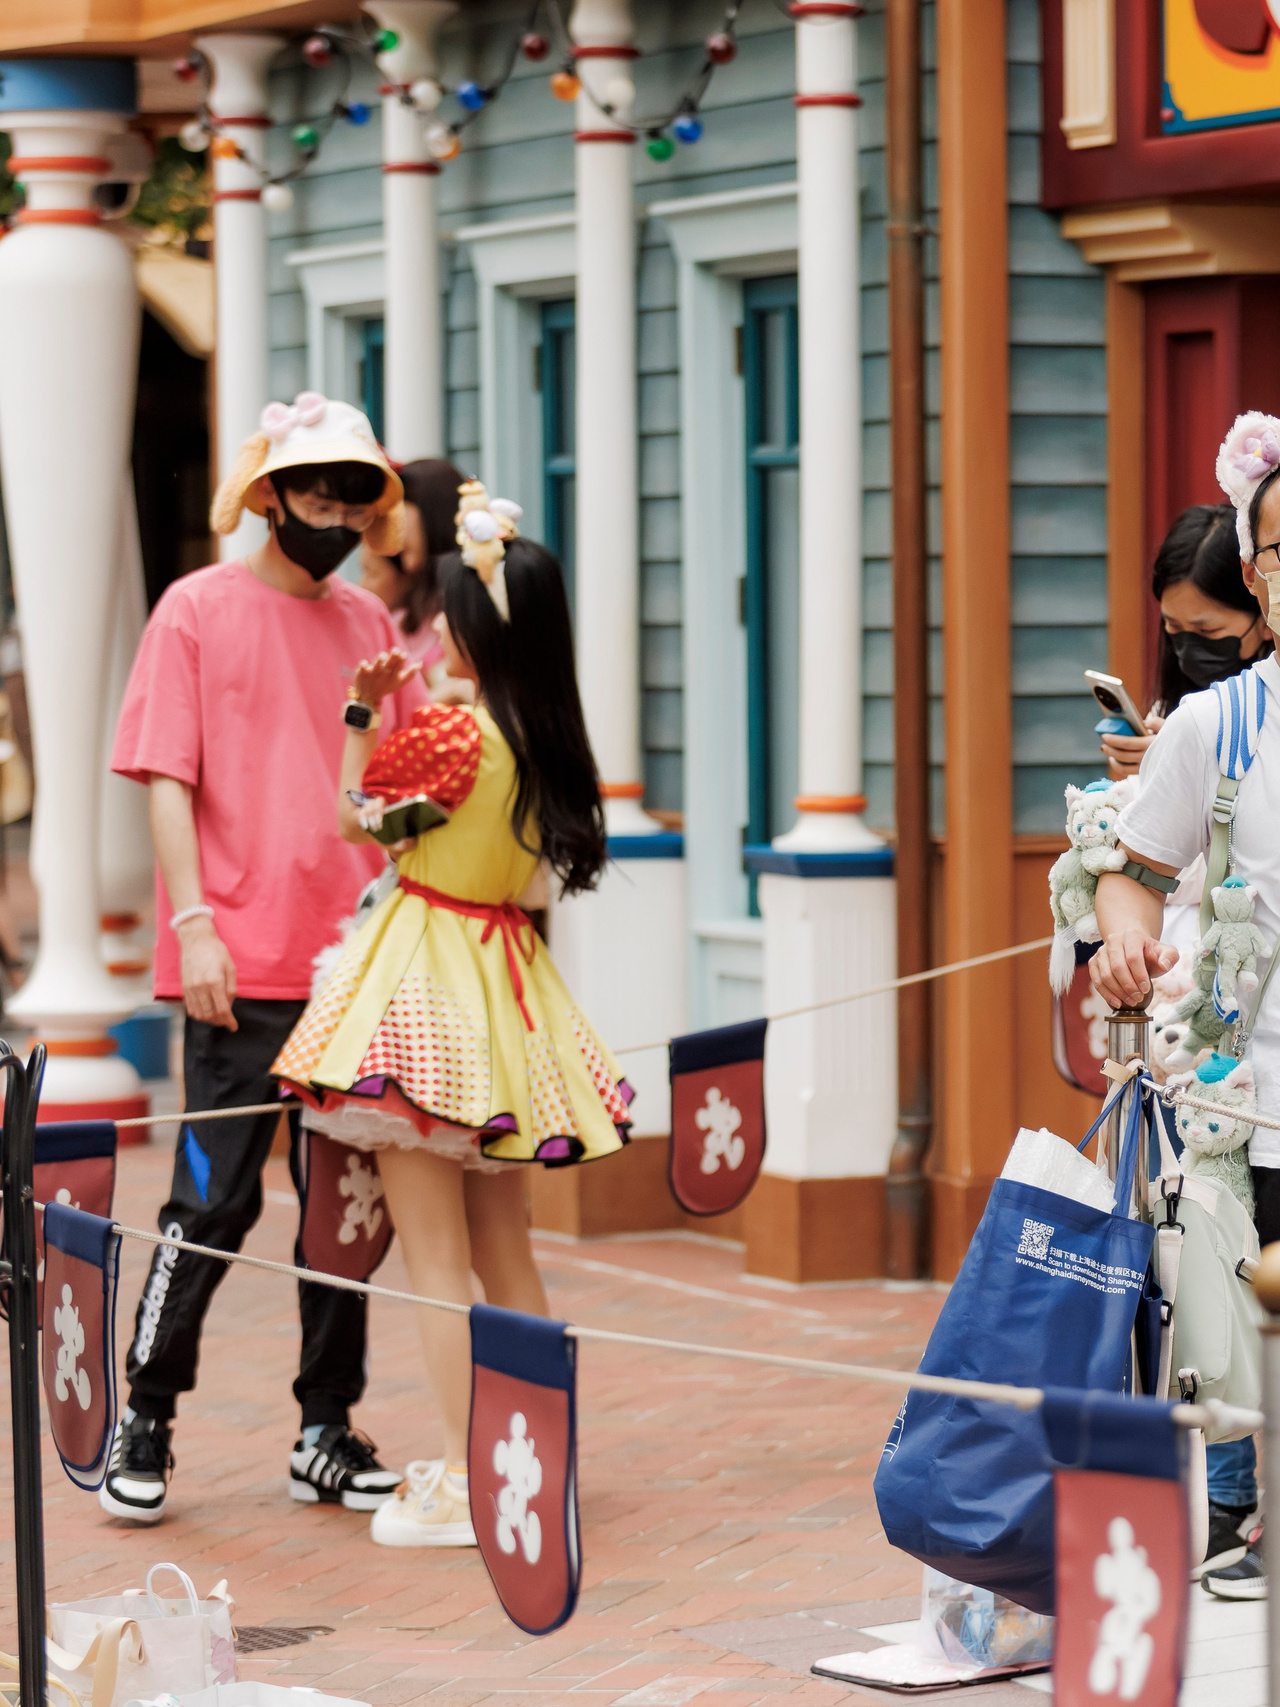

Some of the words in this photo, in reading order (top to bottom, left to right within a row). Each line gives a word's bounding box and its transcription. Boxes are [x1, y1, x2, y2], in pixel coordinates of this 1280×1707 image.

[1015, 1256, 1126, 1295] www.shanghaidisneyresort.com
[1047, 1256, 1063, 1268] Scan
[1064, 1262, 1071, 1270] to
[1072, 1264, 1098, 1280] download
[1097, 1273, 1107, 1283] the
[1107, 1276, 1139, 1289] Shanghai
